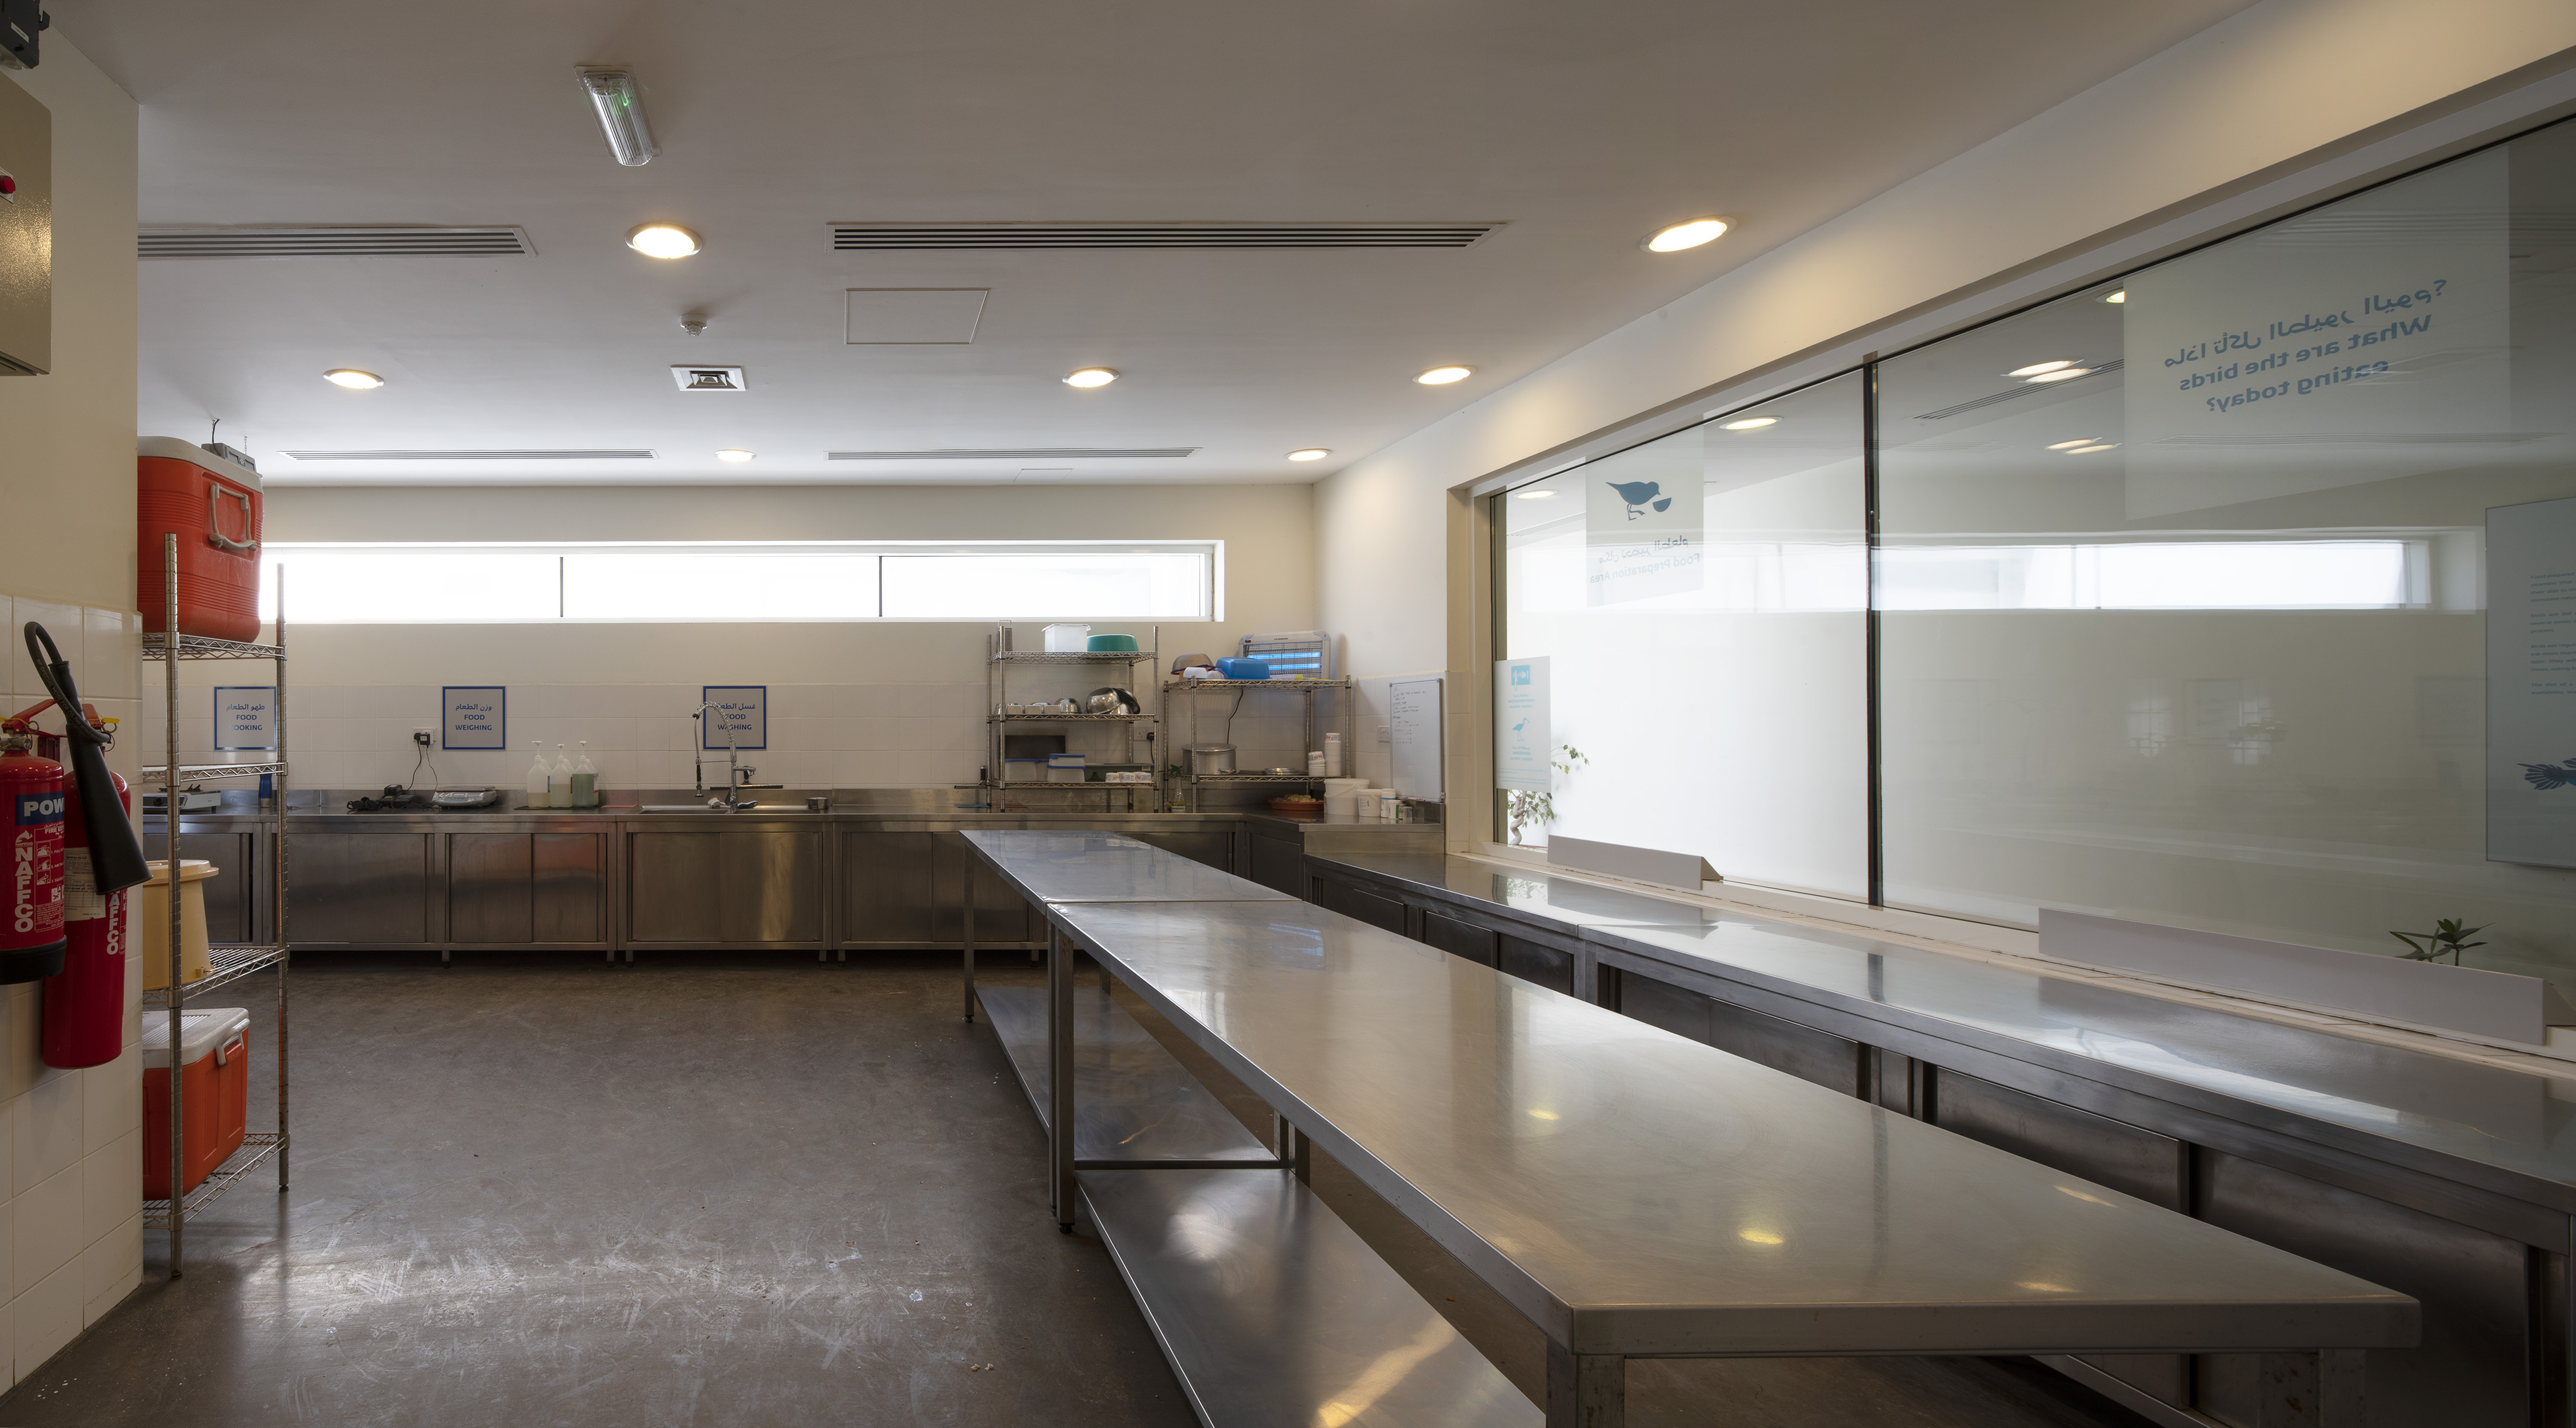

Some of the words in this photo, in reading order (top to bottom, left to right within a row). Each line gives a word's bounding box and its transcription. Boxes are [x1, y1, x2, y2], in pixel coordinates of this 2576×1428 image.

[40, 666, 53, 688] SPECIAL
[51, 686, 62, 701] HOSE
[60, 699, 69, 712] FOR
[15, 847, 34, 933] NAFFCO
[107, 890, 120, 955] AFFCO
